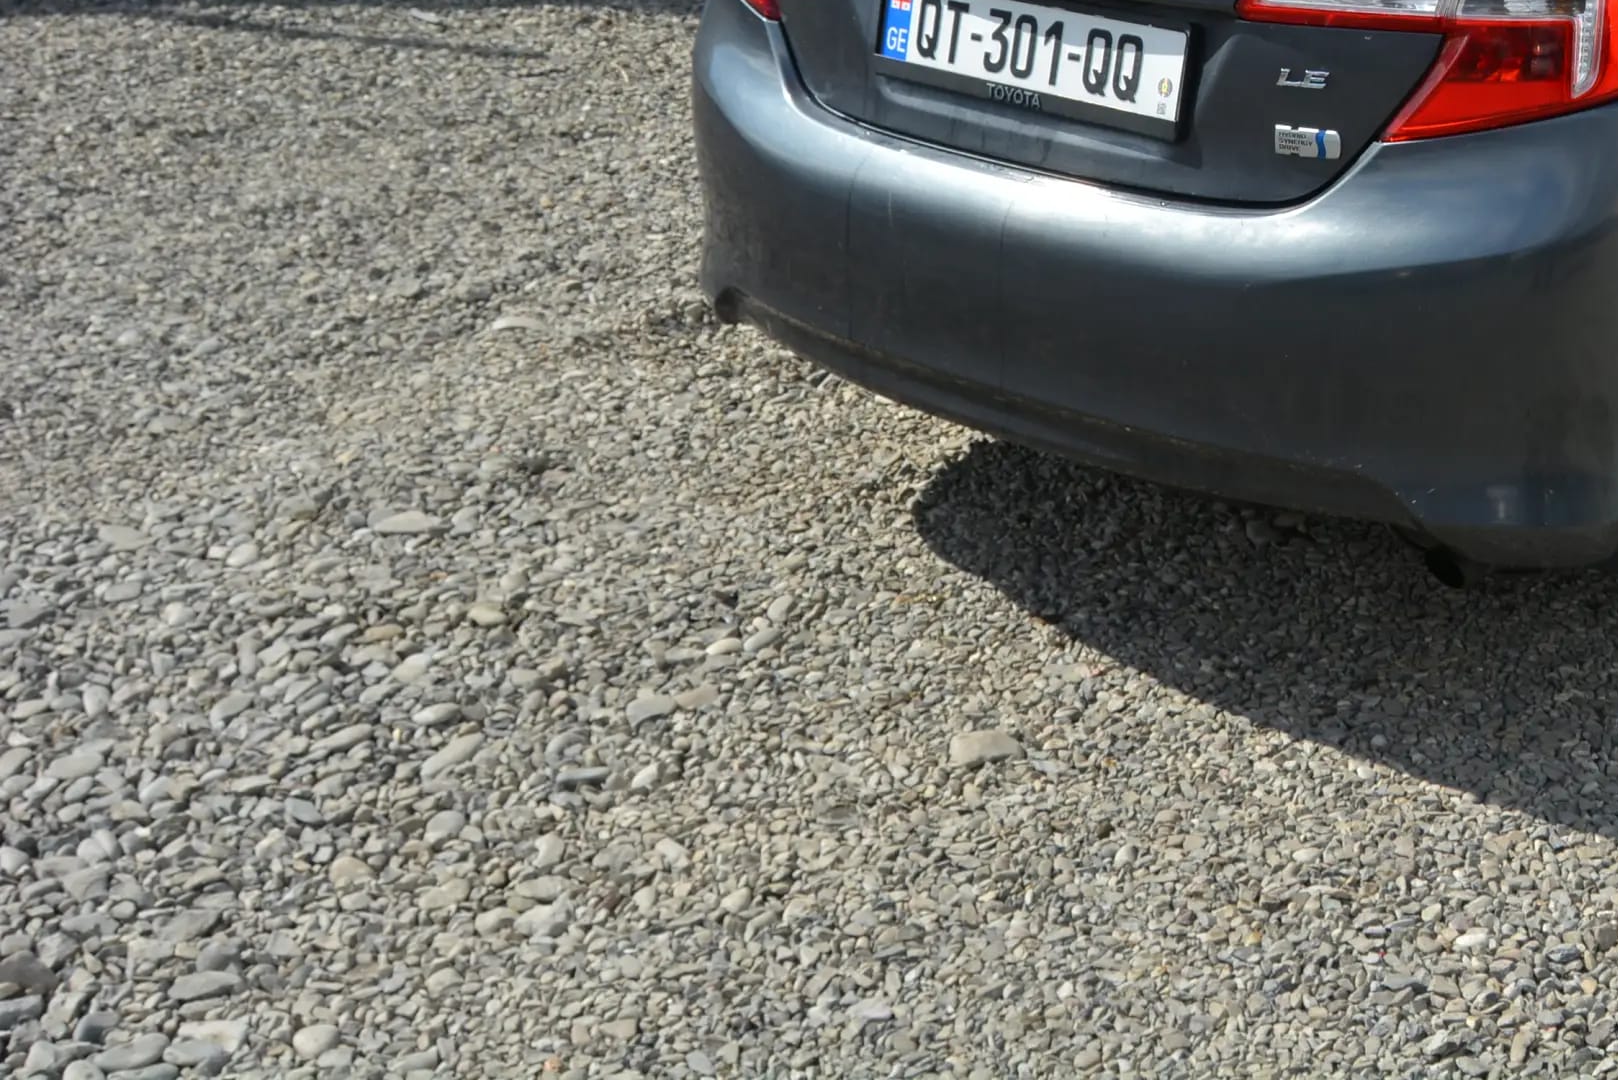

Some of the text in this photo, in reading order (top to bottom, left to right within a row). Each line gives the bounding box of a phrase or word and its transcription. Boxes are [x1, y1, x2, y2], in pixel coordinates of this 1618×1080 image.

[886, 26, 908, 53] GE
[1276, 68, 1330, 89] LE
[986, 82, 1041, 111] TOYOTA
